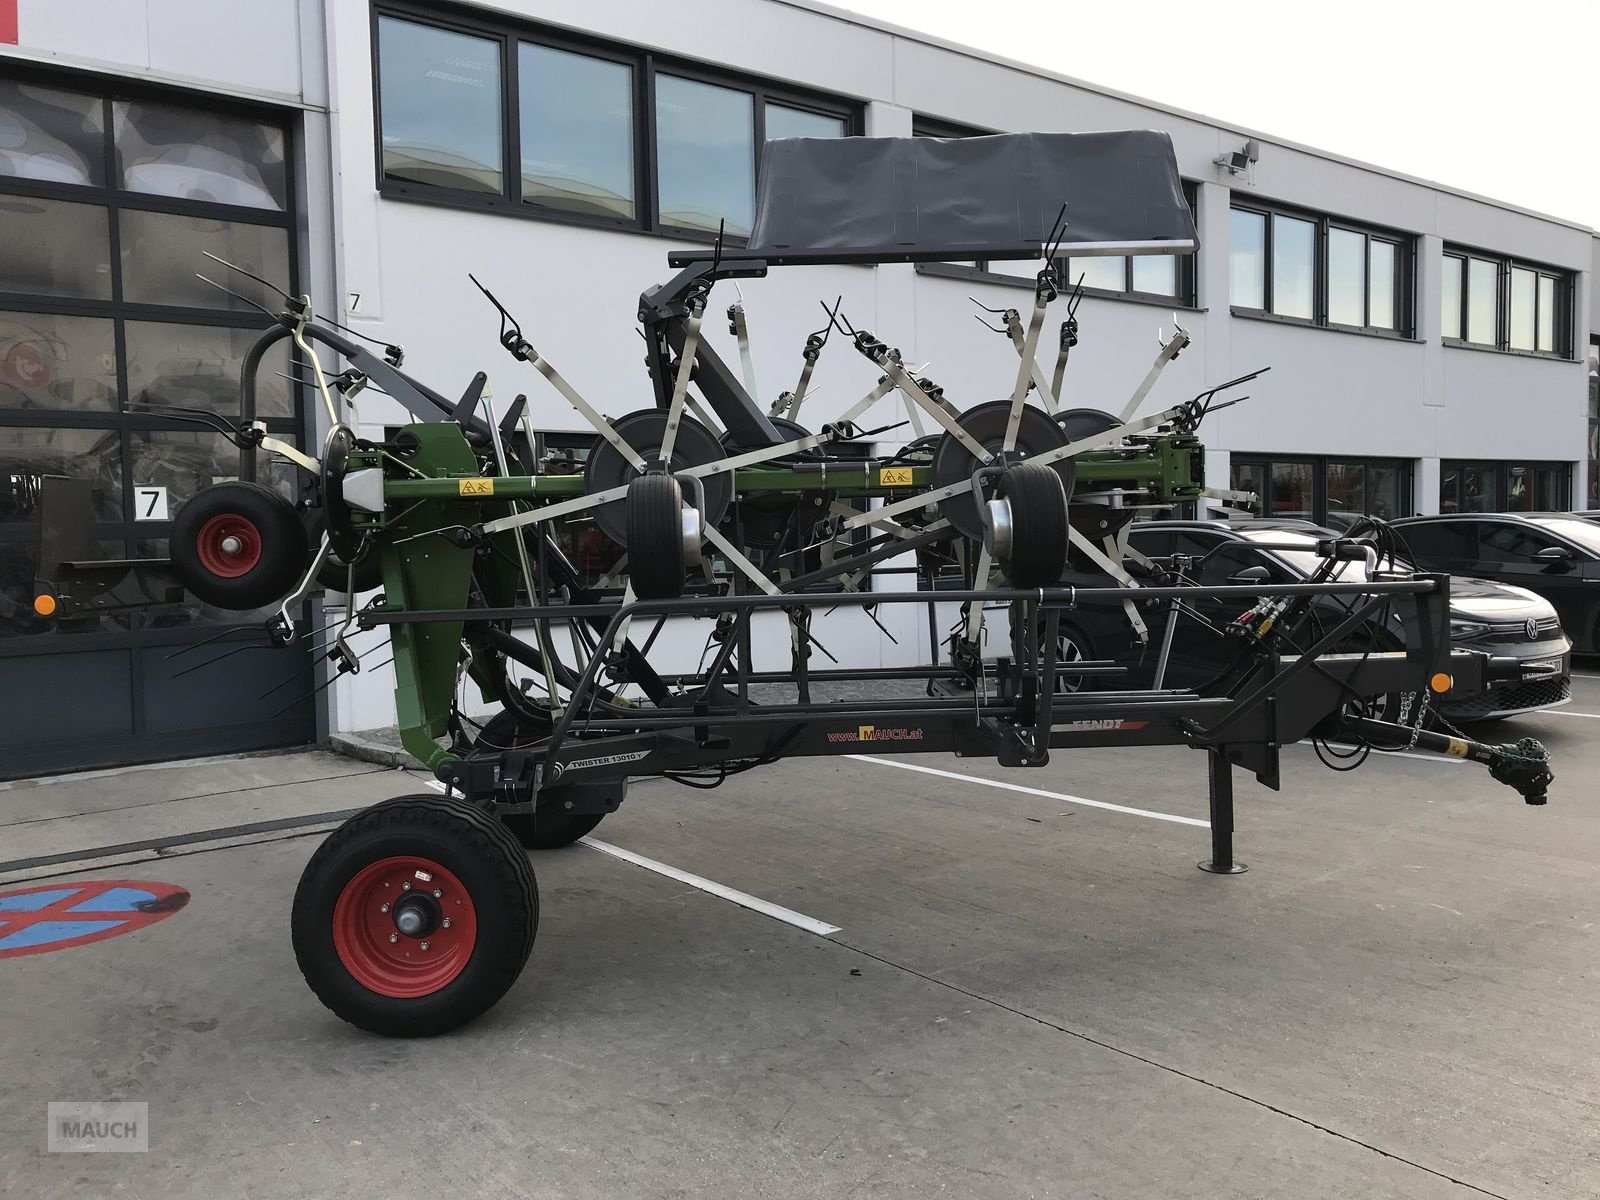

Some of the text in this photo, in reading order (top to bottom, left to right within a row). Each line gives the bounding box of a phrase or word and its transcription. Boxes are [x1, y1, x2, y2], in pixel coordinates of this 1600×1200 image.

[350, 293, 360, 310] 7
[141, 491, 159, 517] 7
[1072, 719, 1124, 730] FENDT
[827, 728, 923, 742] www.MAUCH.at
[571, 757, 610, 768] TWISTER
[612, 753, 636, 762] 13010
